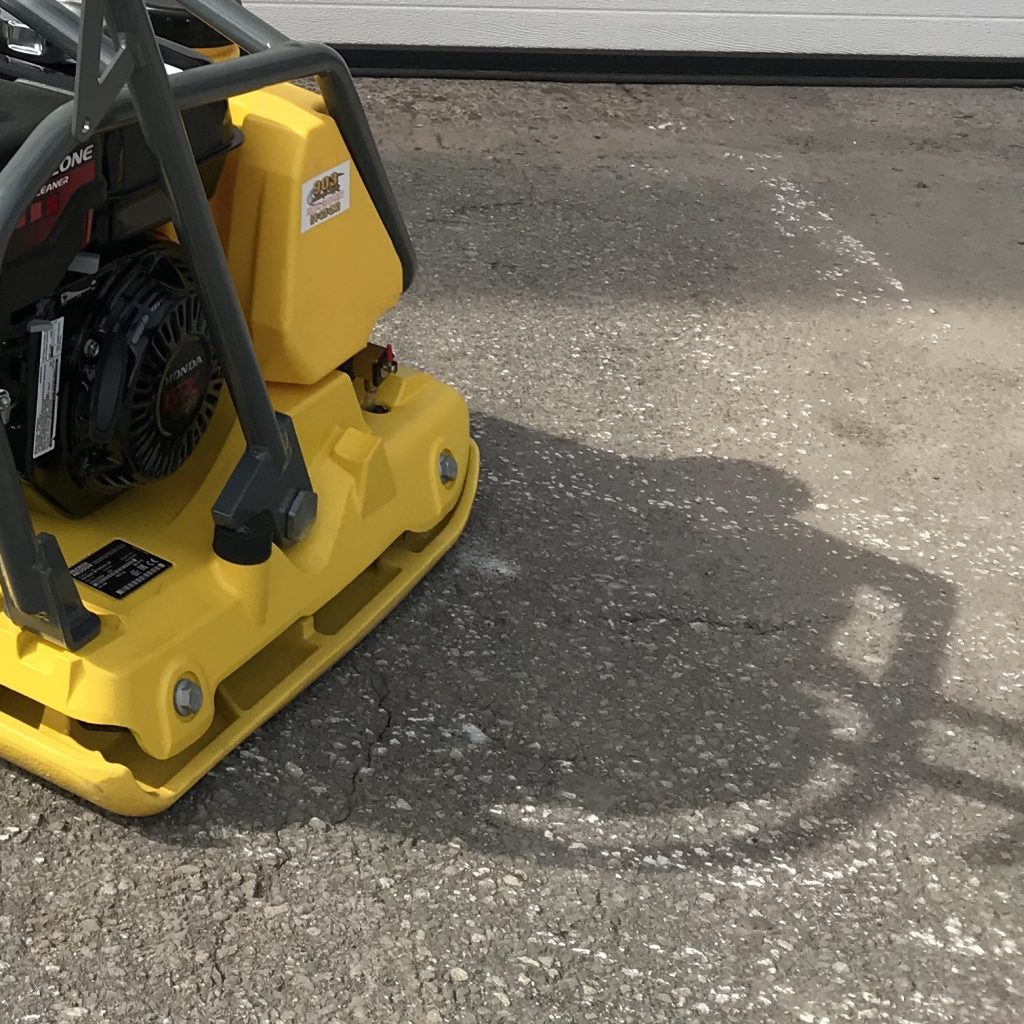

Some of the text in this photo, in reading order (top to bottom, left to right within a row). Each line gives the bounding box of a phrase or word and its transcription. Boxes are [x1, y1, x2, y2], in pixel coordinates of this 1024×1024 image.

[52, 144, 94, 176] ONE
[36, 175, 69, 197] EANER
[165, 355, 203, 386] HONDA
